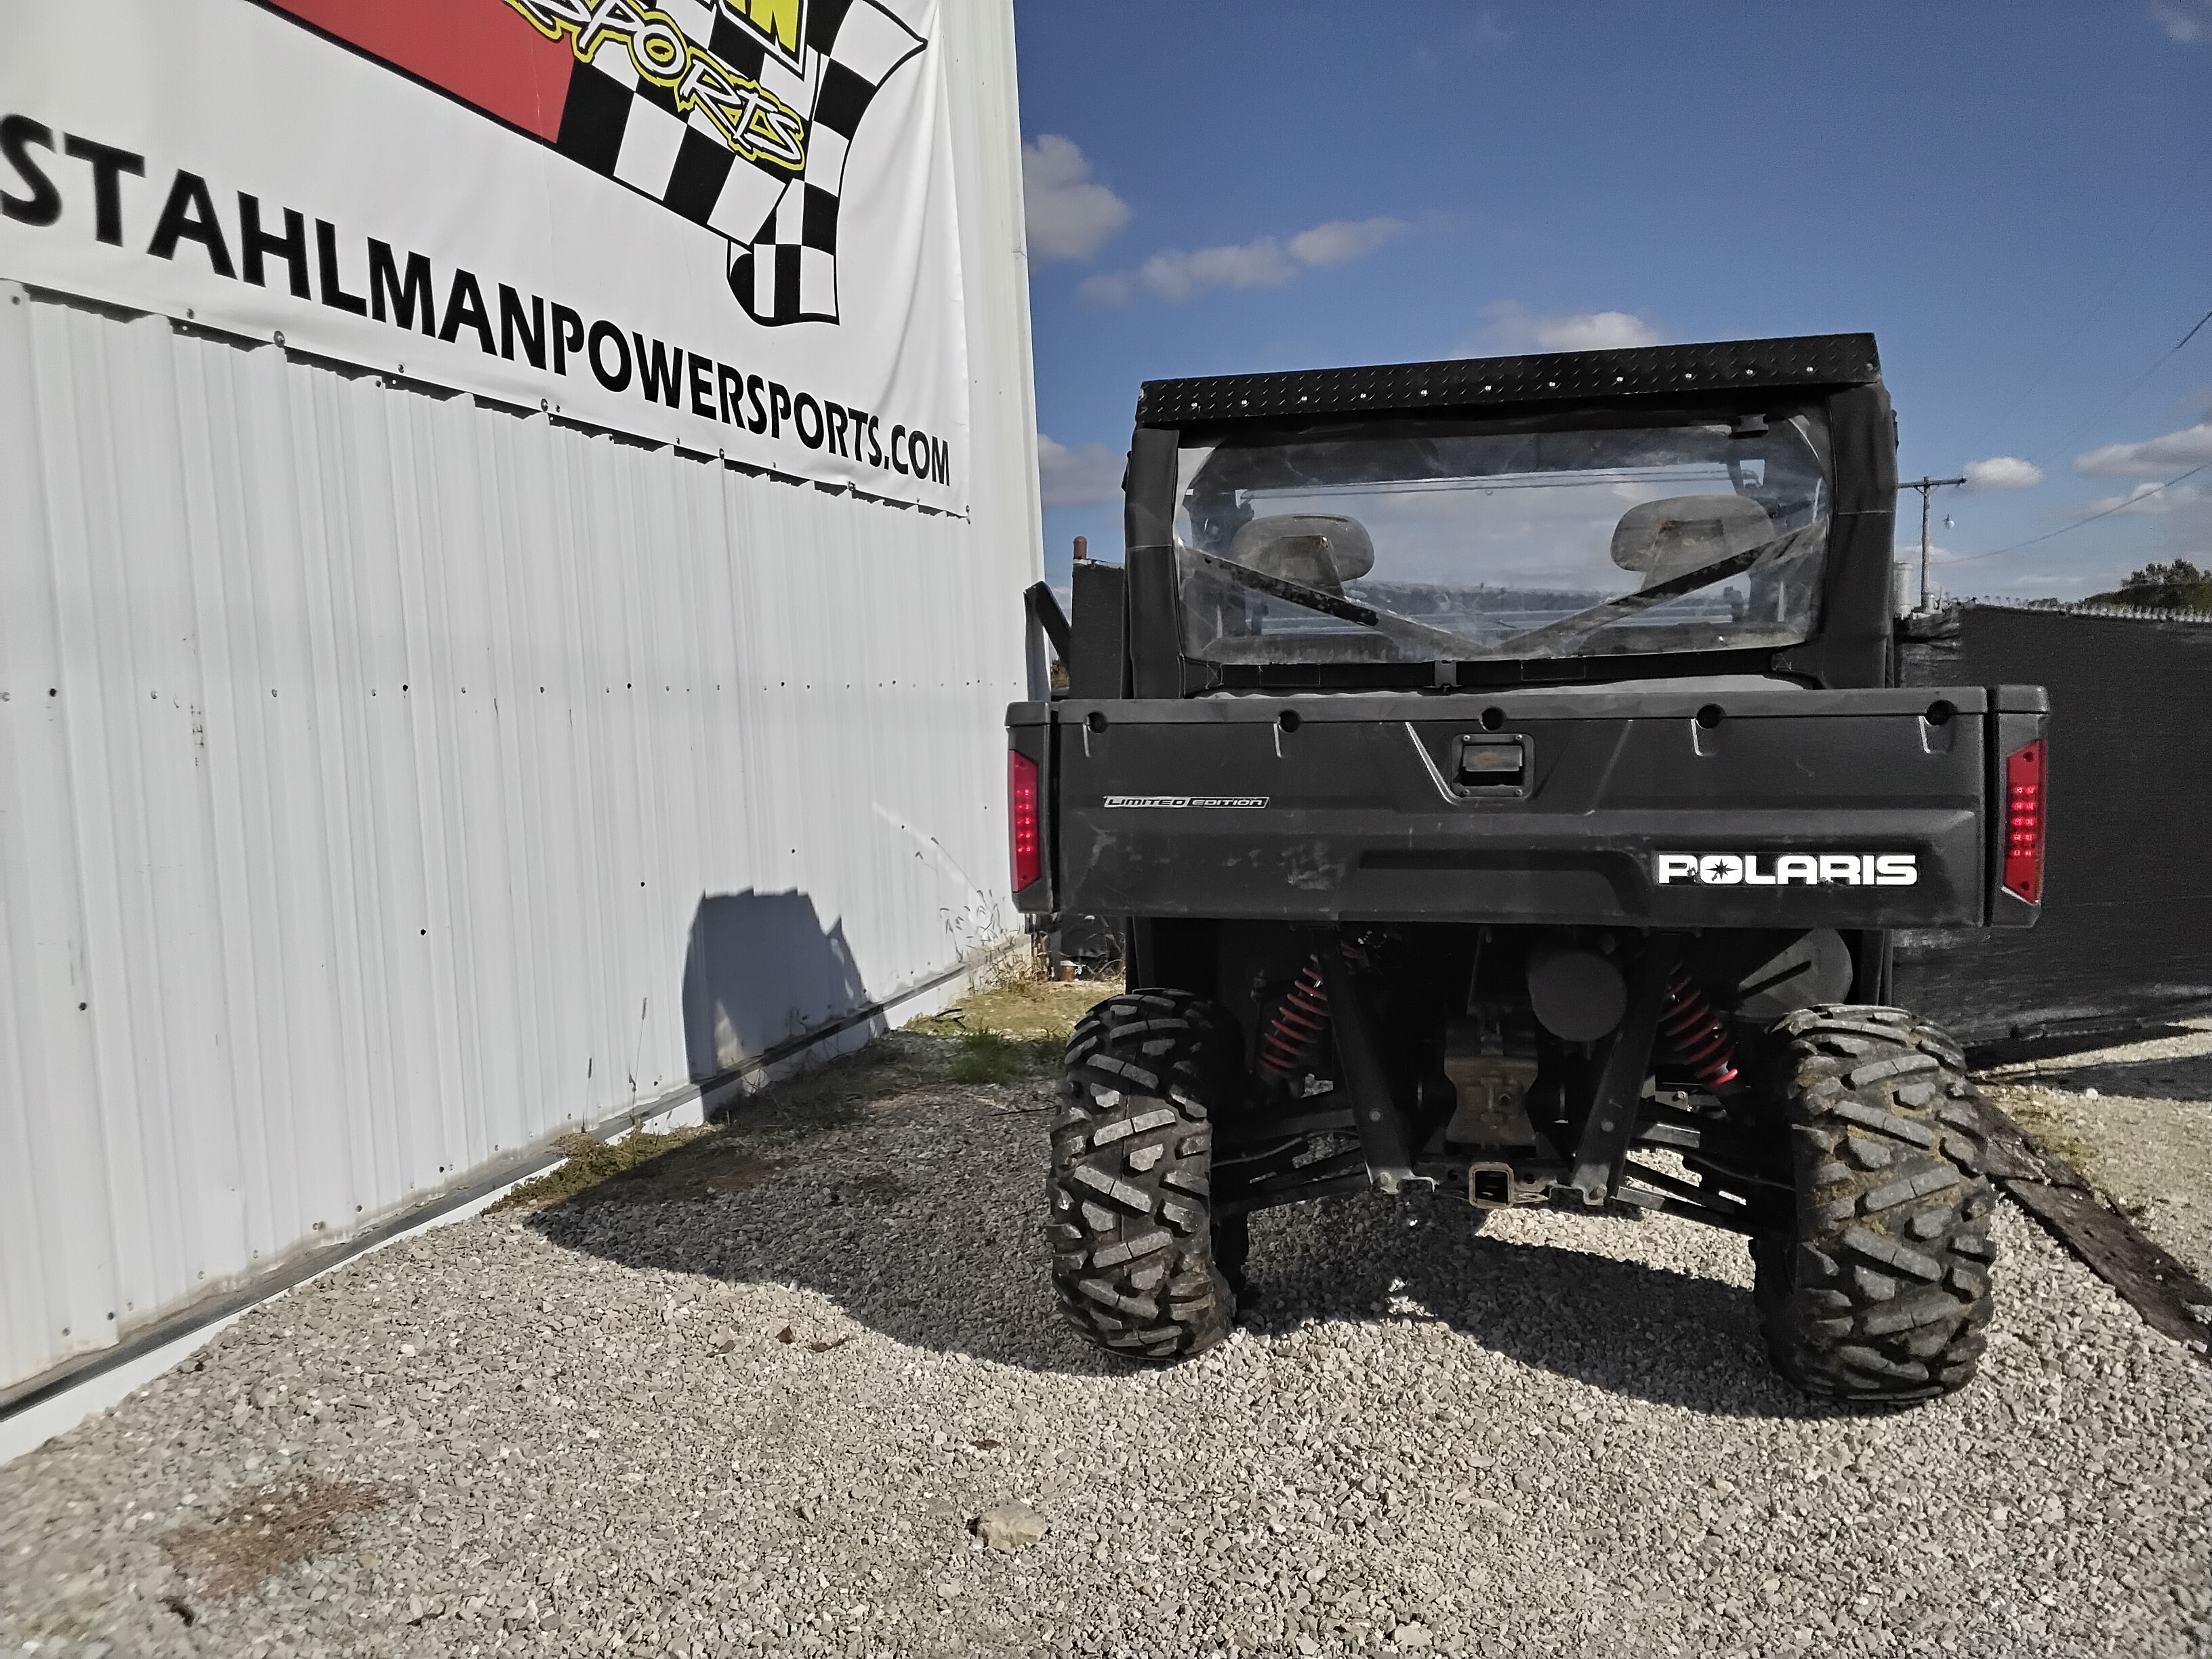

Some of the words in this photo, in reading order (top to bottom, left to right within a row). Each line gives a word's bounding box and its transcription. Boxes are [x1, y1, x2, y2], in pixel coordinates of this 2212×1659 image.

[0, 113, 950, 487] STAHLMANPOWERSPORTS.COM
[1107, 798, 1187, 806] LIMITED
[1191, 798, 1263, 807] EDITION
[1658, 855, 1918, 886] POLARIS
